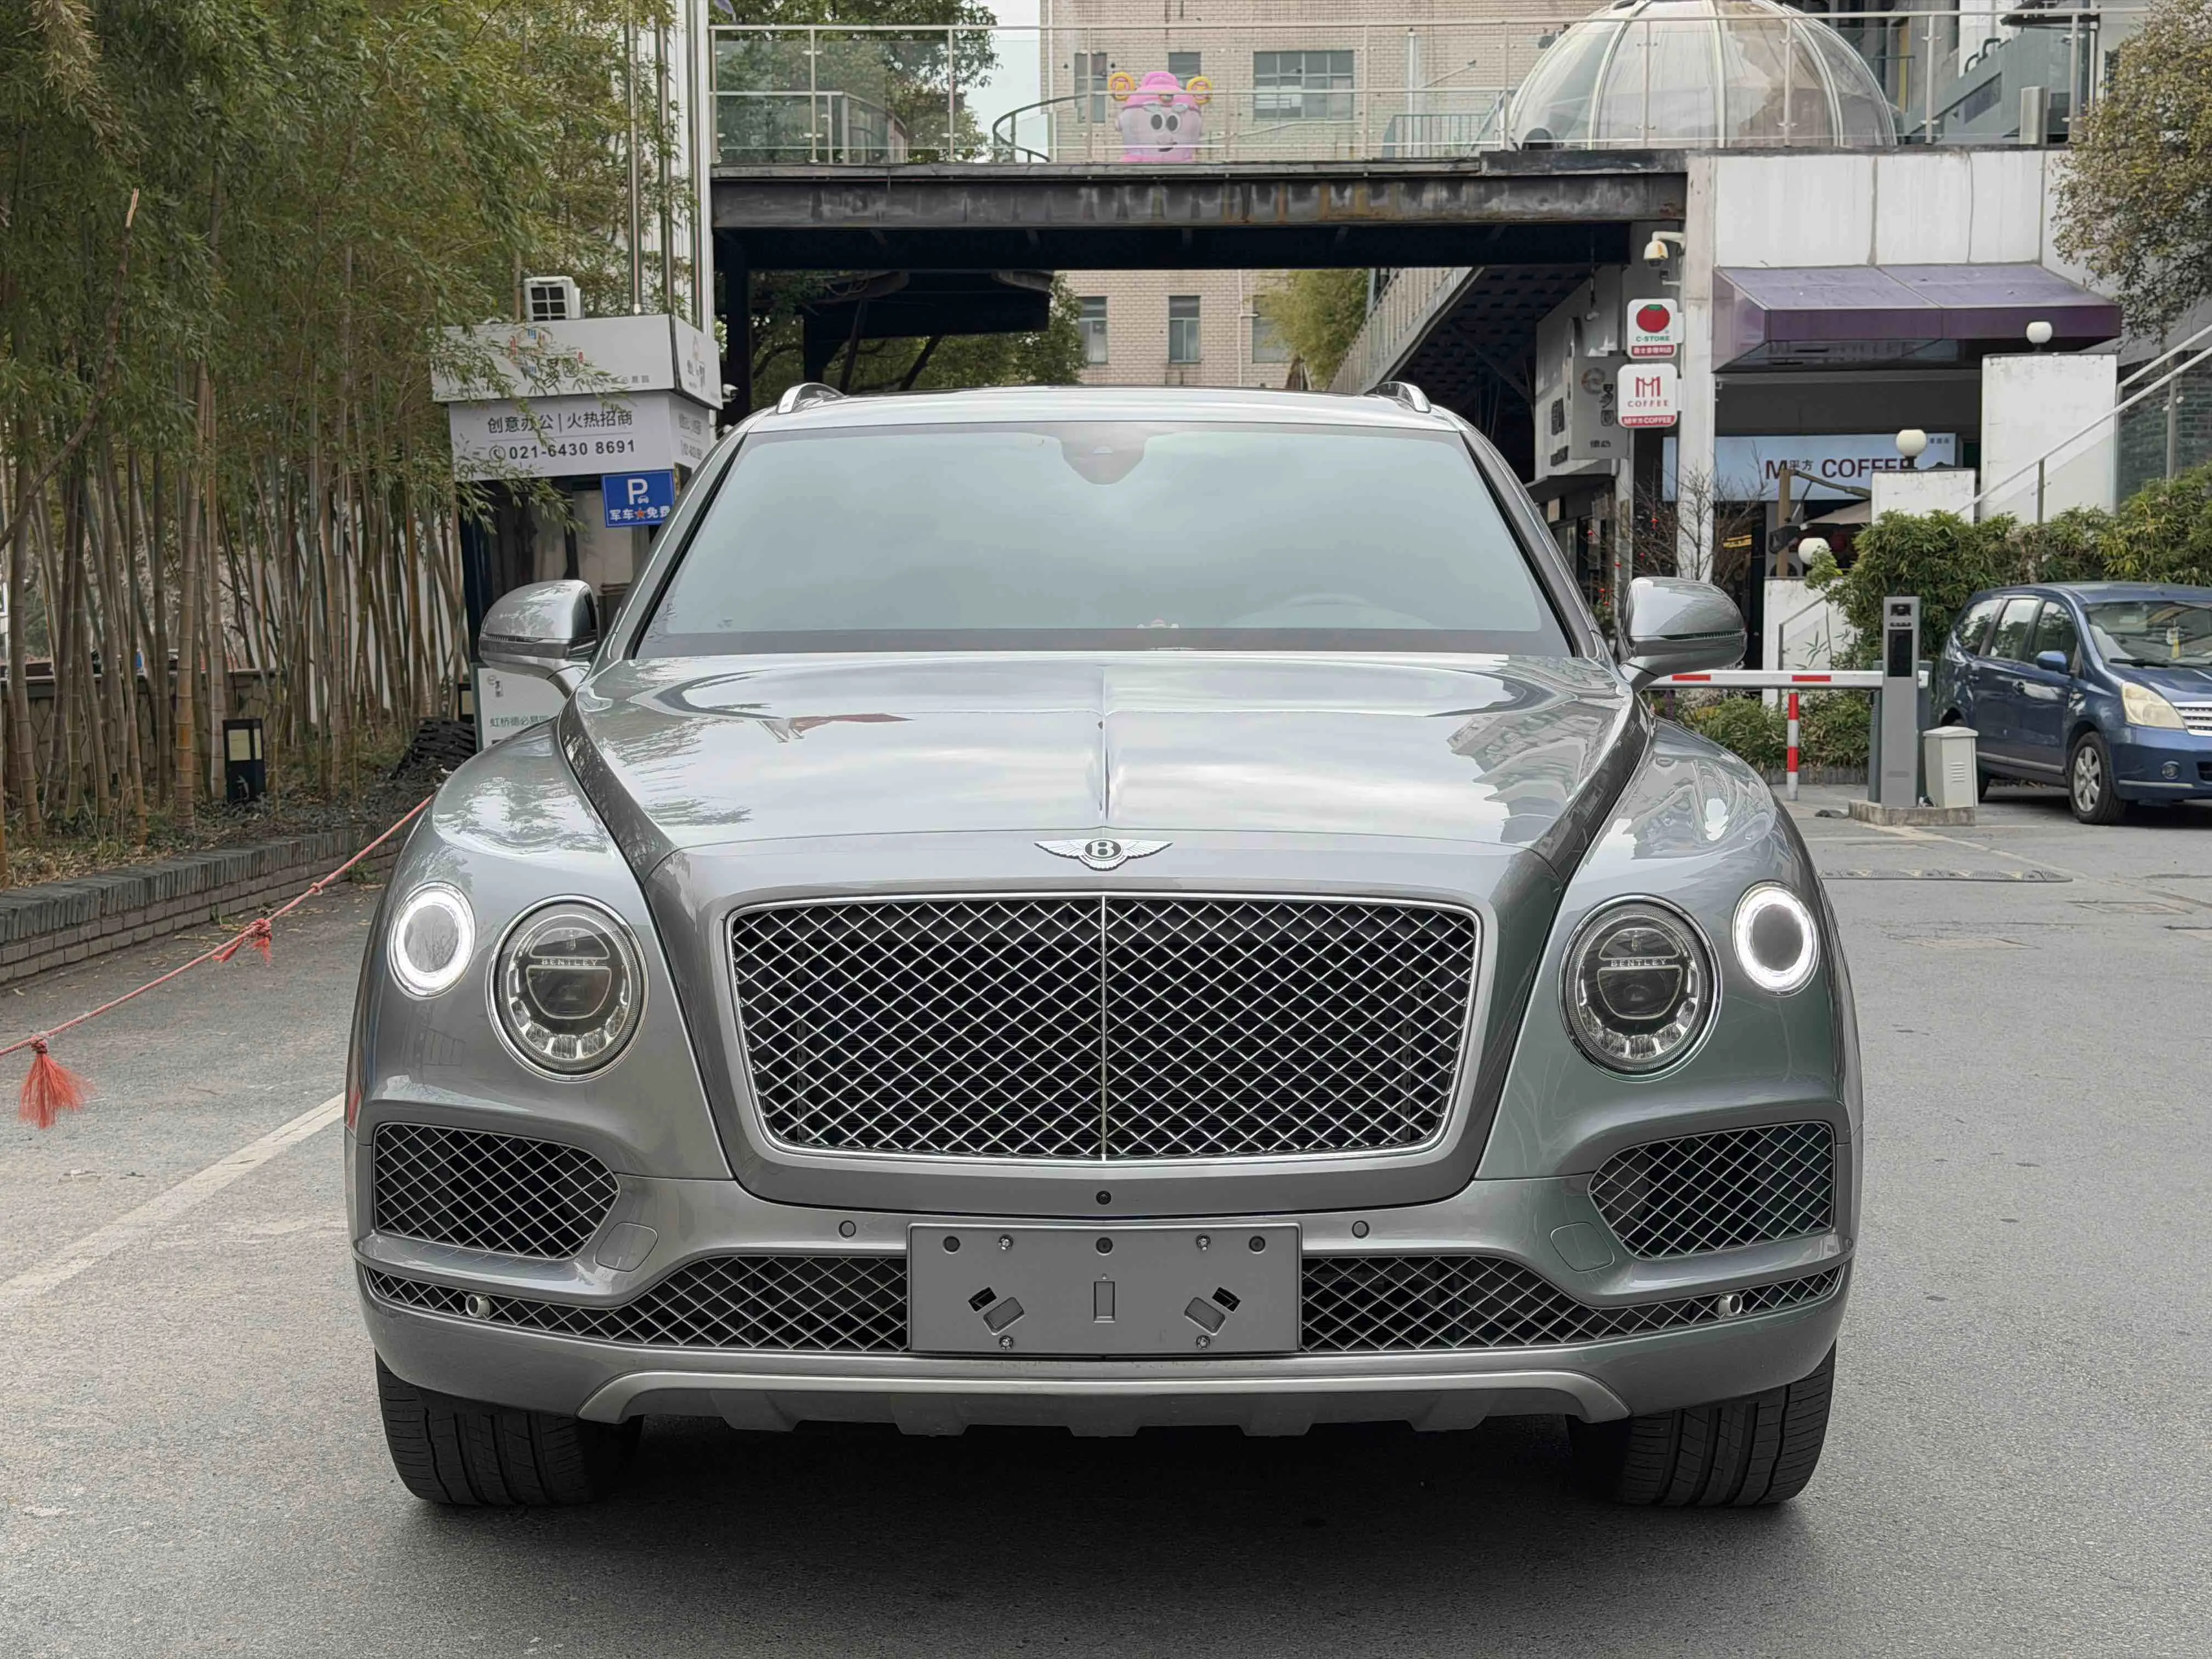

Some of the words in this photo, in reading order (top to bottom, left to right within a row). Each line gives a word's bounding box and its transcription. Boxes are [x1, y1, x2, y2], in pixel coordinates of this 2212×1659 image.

[1627, 399, 1668, 408] COFFEE
[567, 410, 633, 429] 火热招商
[509, 442, 588, 460] 021-6430
[595, 439, 635, 454] 8691
[627, 478, 648, 505] P
[609, 509, 634, 521] 军车
[1610, 957, 1666, 967] BENTLEY
